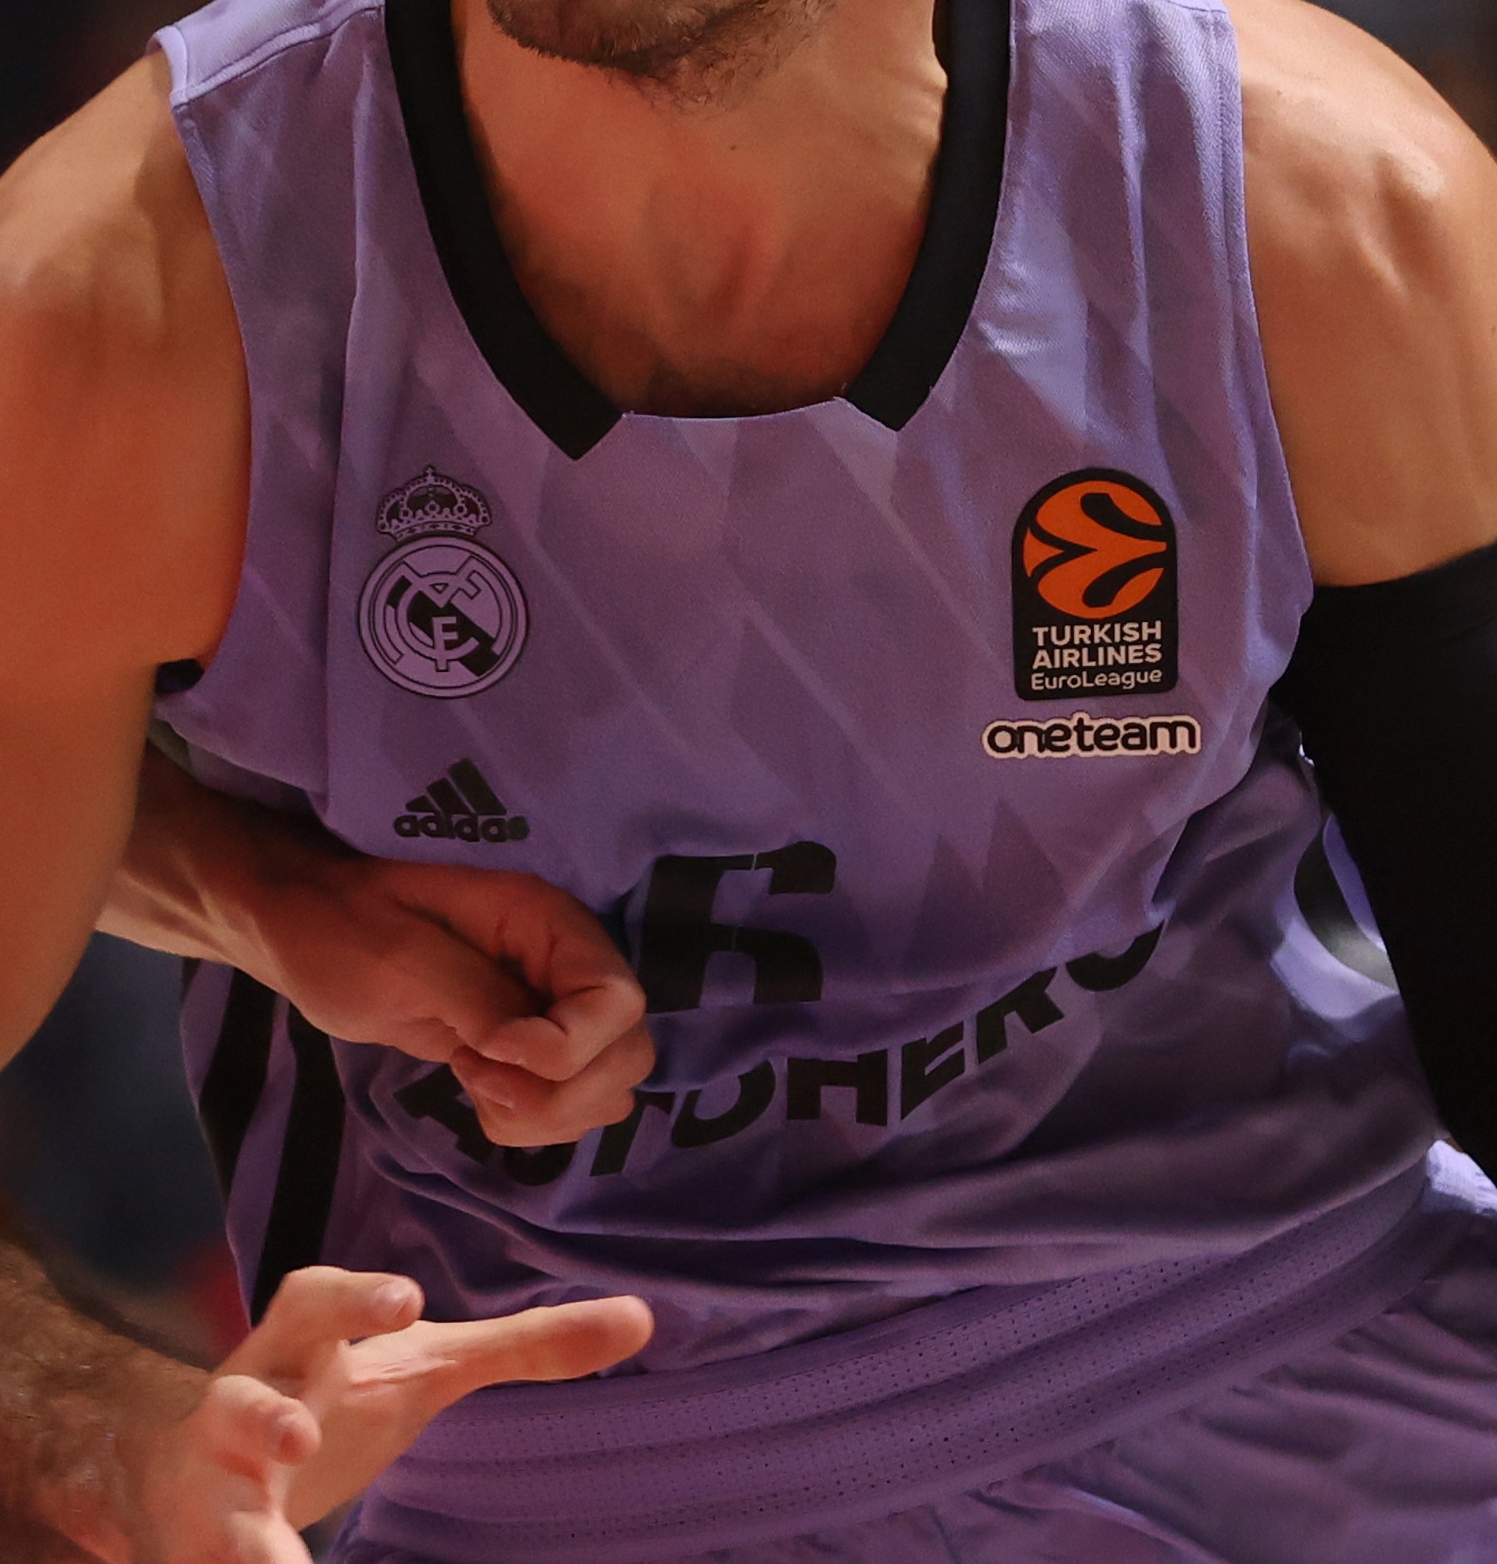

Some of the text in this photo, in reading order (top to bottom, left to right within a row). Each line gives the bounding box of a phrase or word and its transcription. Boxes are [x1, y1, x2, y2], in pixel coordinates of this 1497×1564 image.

[1032, 619, 1162, 647] TURKISH
[1032, 643, 1163, 670] AIRLINES
[1031, 669, 1163, 690] EuroLeague
[987, 716, 1197, 754] oneteam
[393, 809, 531, 843] adidas
[637, 840, 837, 1014] 6
